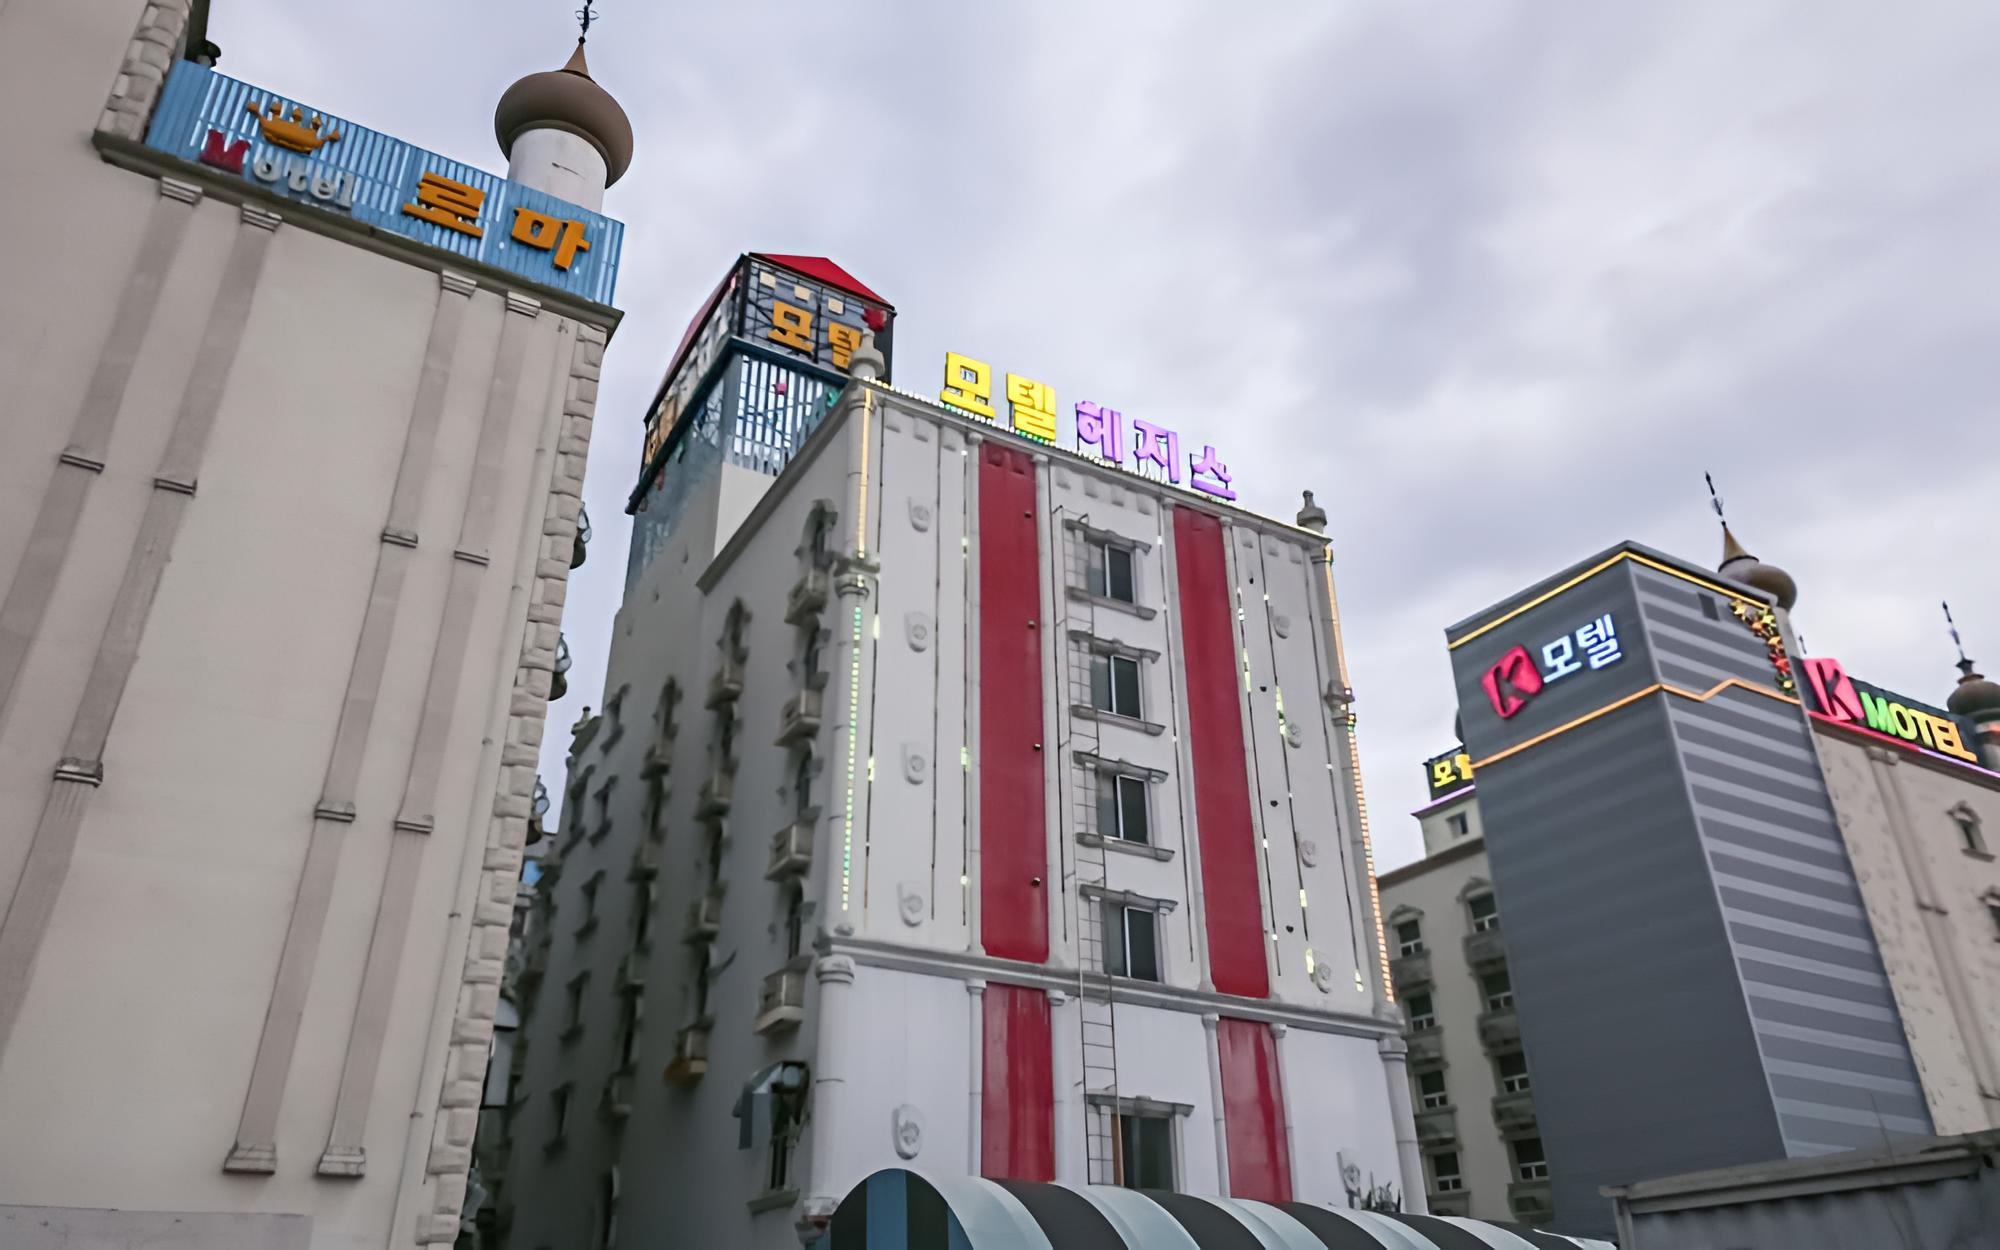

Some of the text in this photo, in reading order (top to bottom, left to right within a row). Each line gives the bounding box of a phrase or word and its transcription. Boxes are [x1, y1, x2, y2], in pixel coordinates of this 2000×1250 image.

[199, 129, 354, 212] Motel
[940, 352, 1236, 501] 모텔 헤지스
[1542, 613, 1622, 684] 모텔
[1859, 692, 1977, 763] MOTEL
